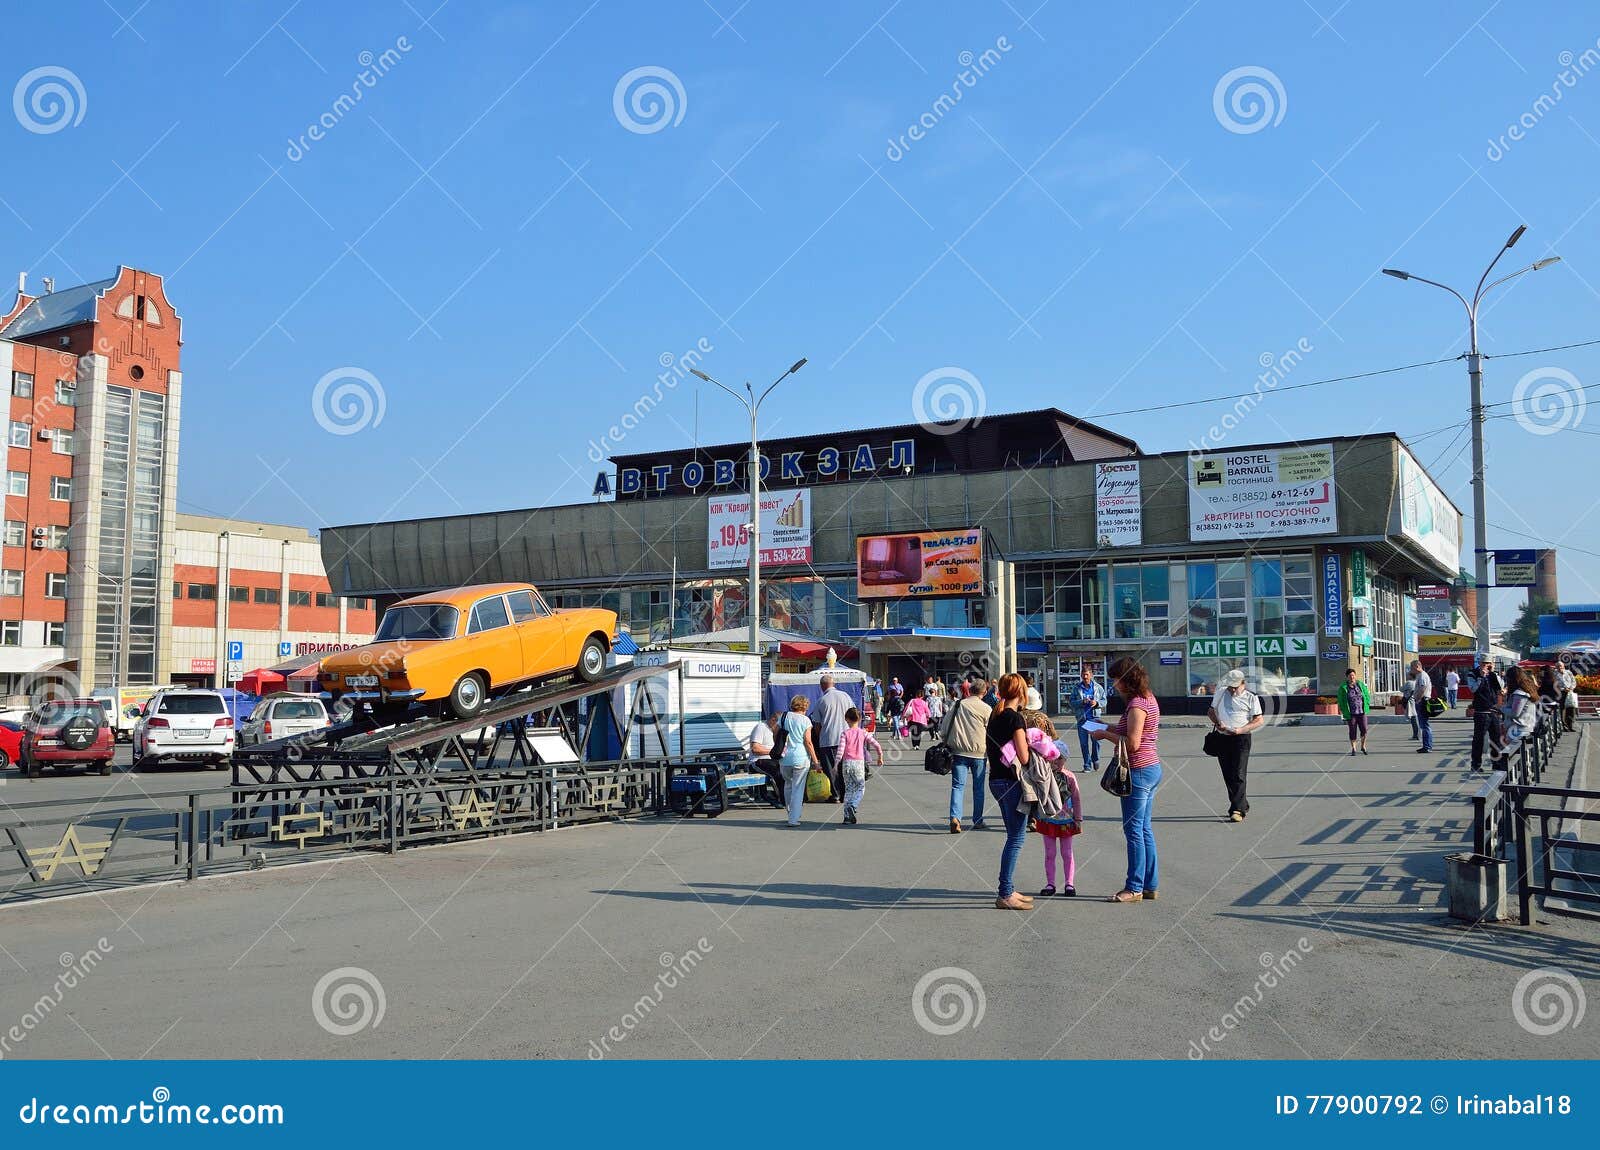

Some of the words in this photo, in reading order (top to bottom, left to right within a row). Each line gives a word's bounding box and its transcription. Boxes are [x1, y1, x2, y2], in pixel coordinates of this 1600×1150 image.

[1227, 454, 1270, 465] HOSTEL
[592, 438, 915, 497] АВТОВОКЗАЛ
[1099, 463, 1136, 474] Хостел
[1227, 465, 1272, 476] BARNAUL
[1232, 491, 1268, 502] 8(3852)
[1271, 488, 1315, 499] 69-12-69
[710, 503, 723, 514] КПК
[725, 498, 783, 514] "Крединвест"
[1098, 499, 1124, 507] 350-500
[1204, 512, 1253, 522] КВАРТИРЫ
[1256, 507, 1320, 519] ПОСУТОЧНО
[1196, 522, 1222, 531] 8(3852)
[1223, 521, 1255, 530] 69-26-25
[1270, 517, 1331, 528] 8-983-389-79-69
[760, 552, 771, 563] ел.
[773, 548, 807, 562] 534-223
[1354, 557, 1363, 596] АПТЕКА
[908, 584, 933, 593] Сутки
[940, 583, 960, 591] 1000
[962, 581, 979, 592] руб
[1327, 556, 1339, 625] АВИАКАССЫ
[231, 643, 240, 659] P
[1191, 639, 1283, 655] АПТЕКА
[698, 663, 741, 674] ПОЛИЦИЯ
